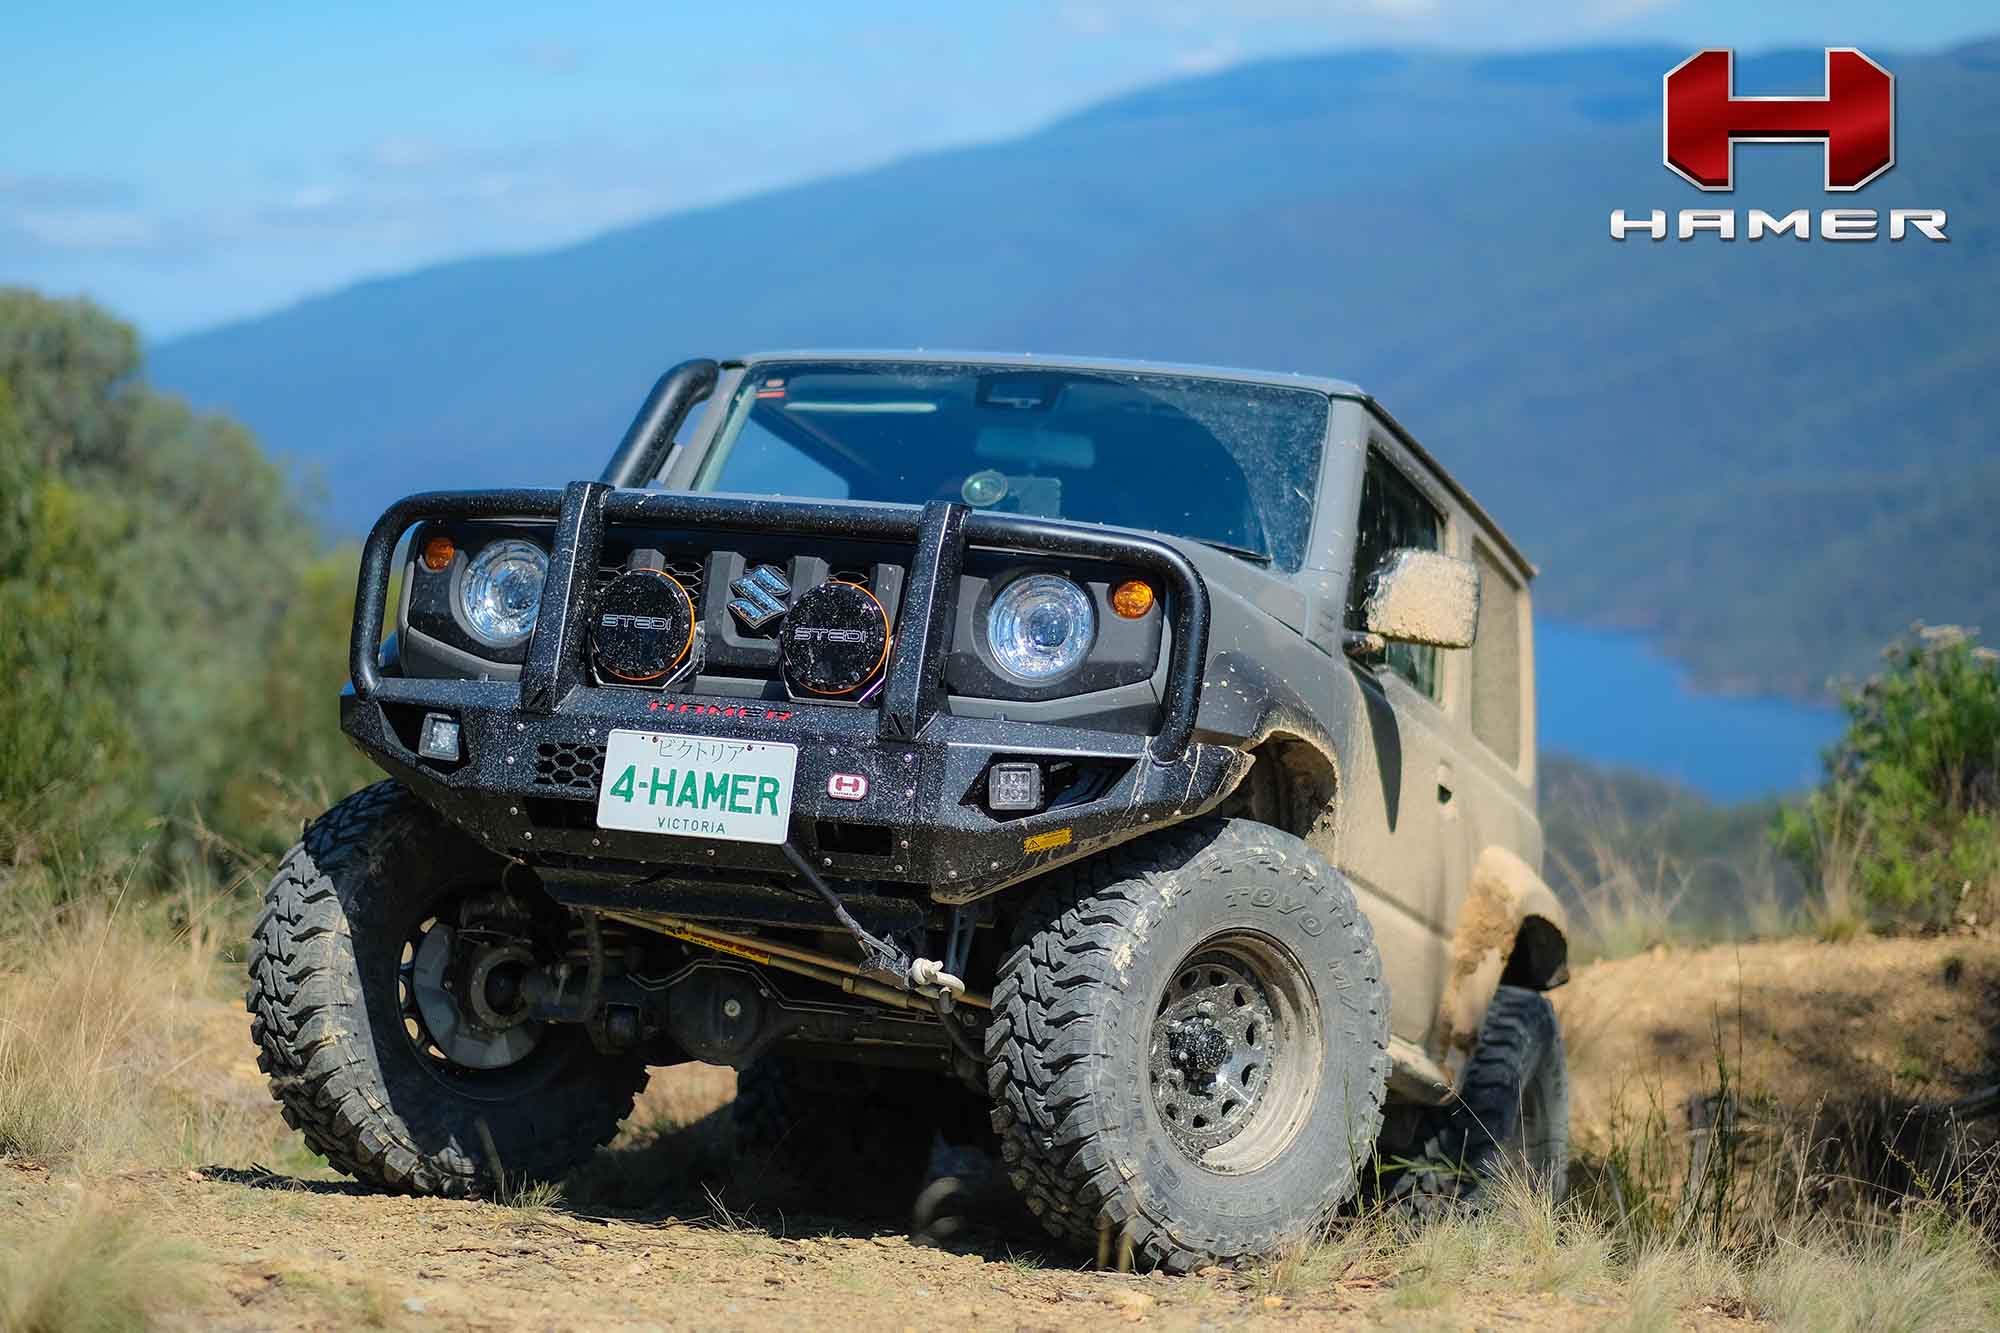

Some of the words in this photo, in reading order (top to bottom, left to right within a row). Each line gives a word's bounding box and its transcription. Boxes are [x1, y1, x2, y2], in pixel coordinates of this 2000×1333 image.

[601, 614, 672, 631] STEDI
[794, 627, 868, 643] STEDI
[649, 700, 792, 721] HAMER
[657, 738, 745, 765] ビクトリア
[609, 764, 781, 817] 4-HAMER
[657, 816, 726, 834] VICTORIA
[1223, 885, 1328, 938] TOYO
